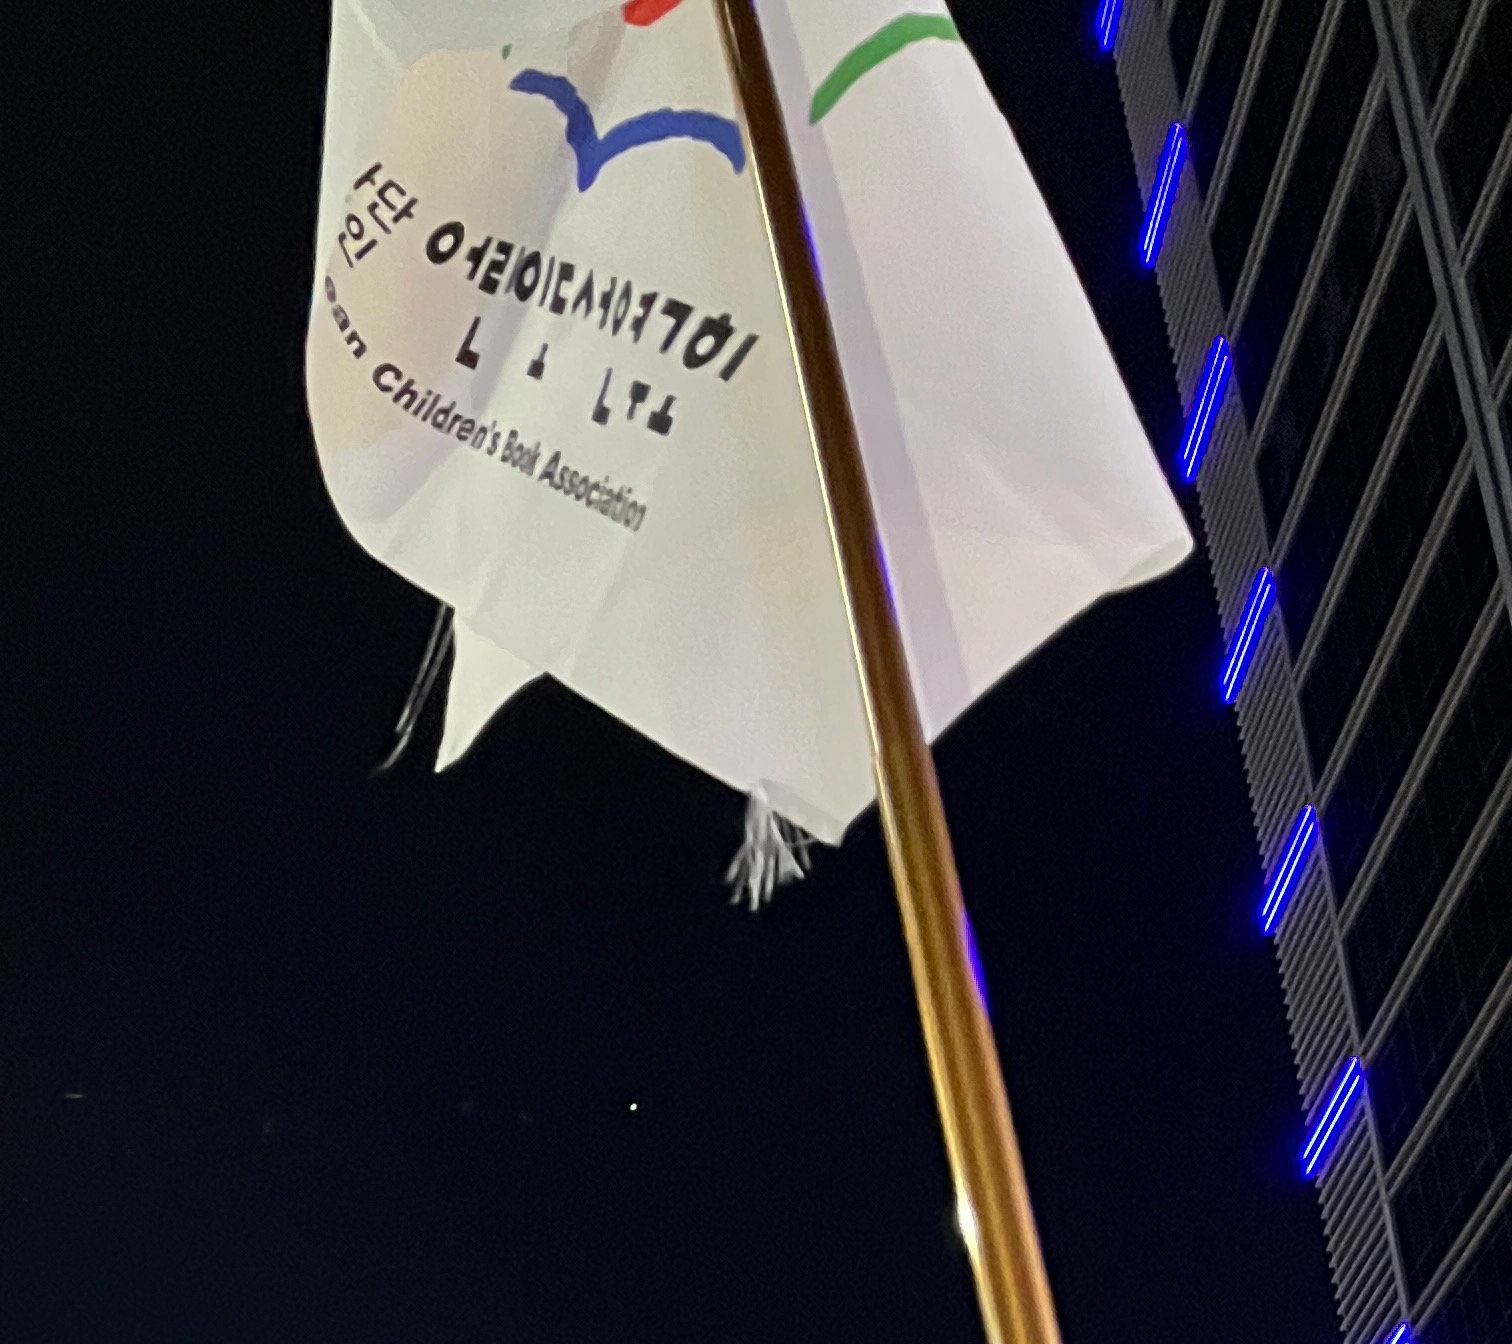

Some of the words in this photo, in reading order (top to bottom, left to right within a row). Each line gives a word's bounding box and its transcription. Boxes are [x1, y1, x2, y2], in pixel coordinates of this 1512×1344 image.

[372, 363, 501, 454] Children's
[500, 430, 541, 476] Book
[538, 450, 647, 533] Association
